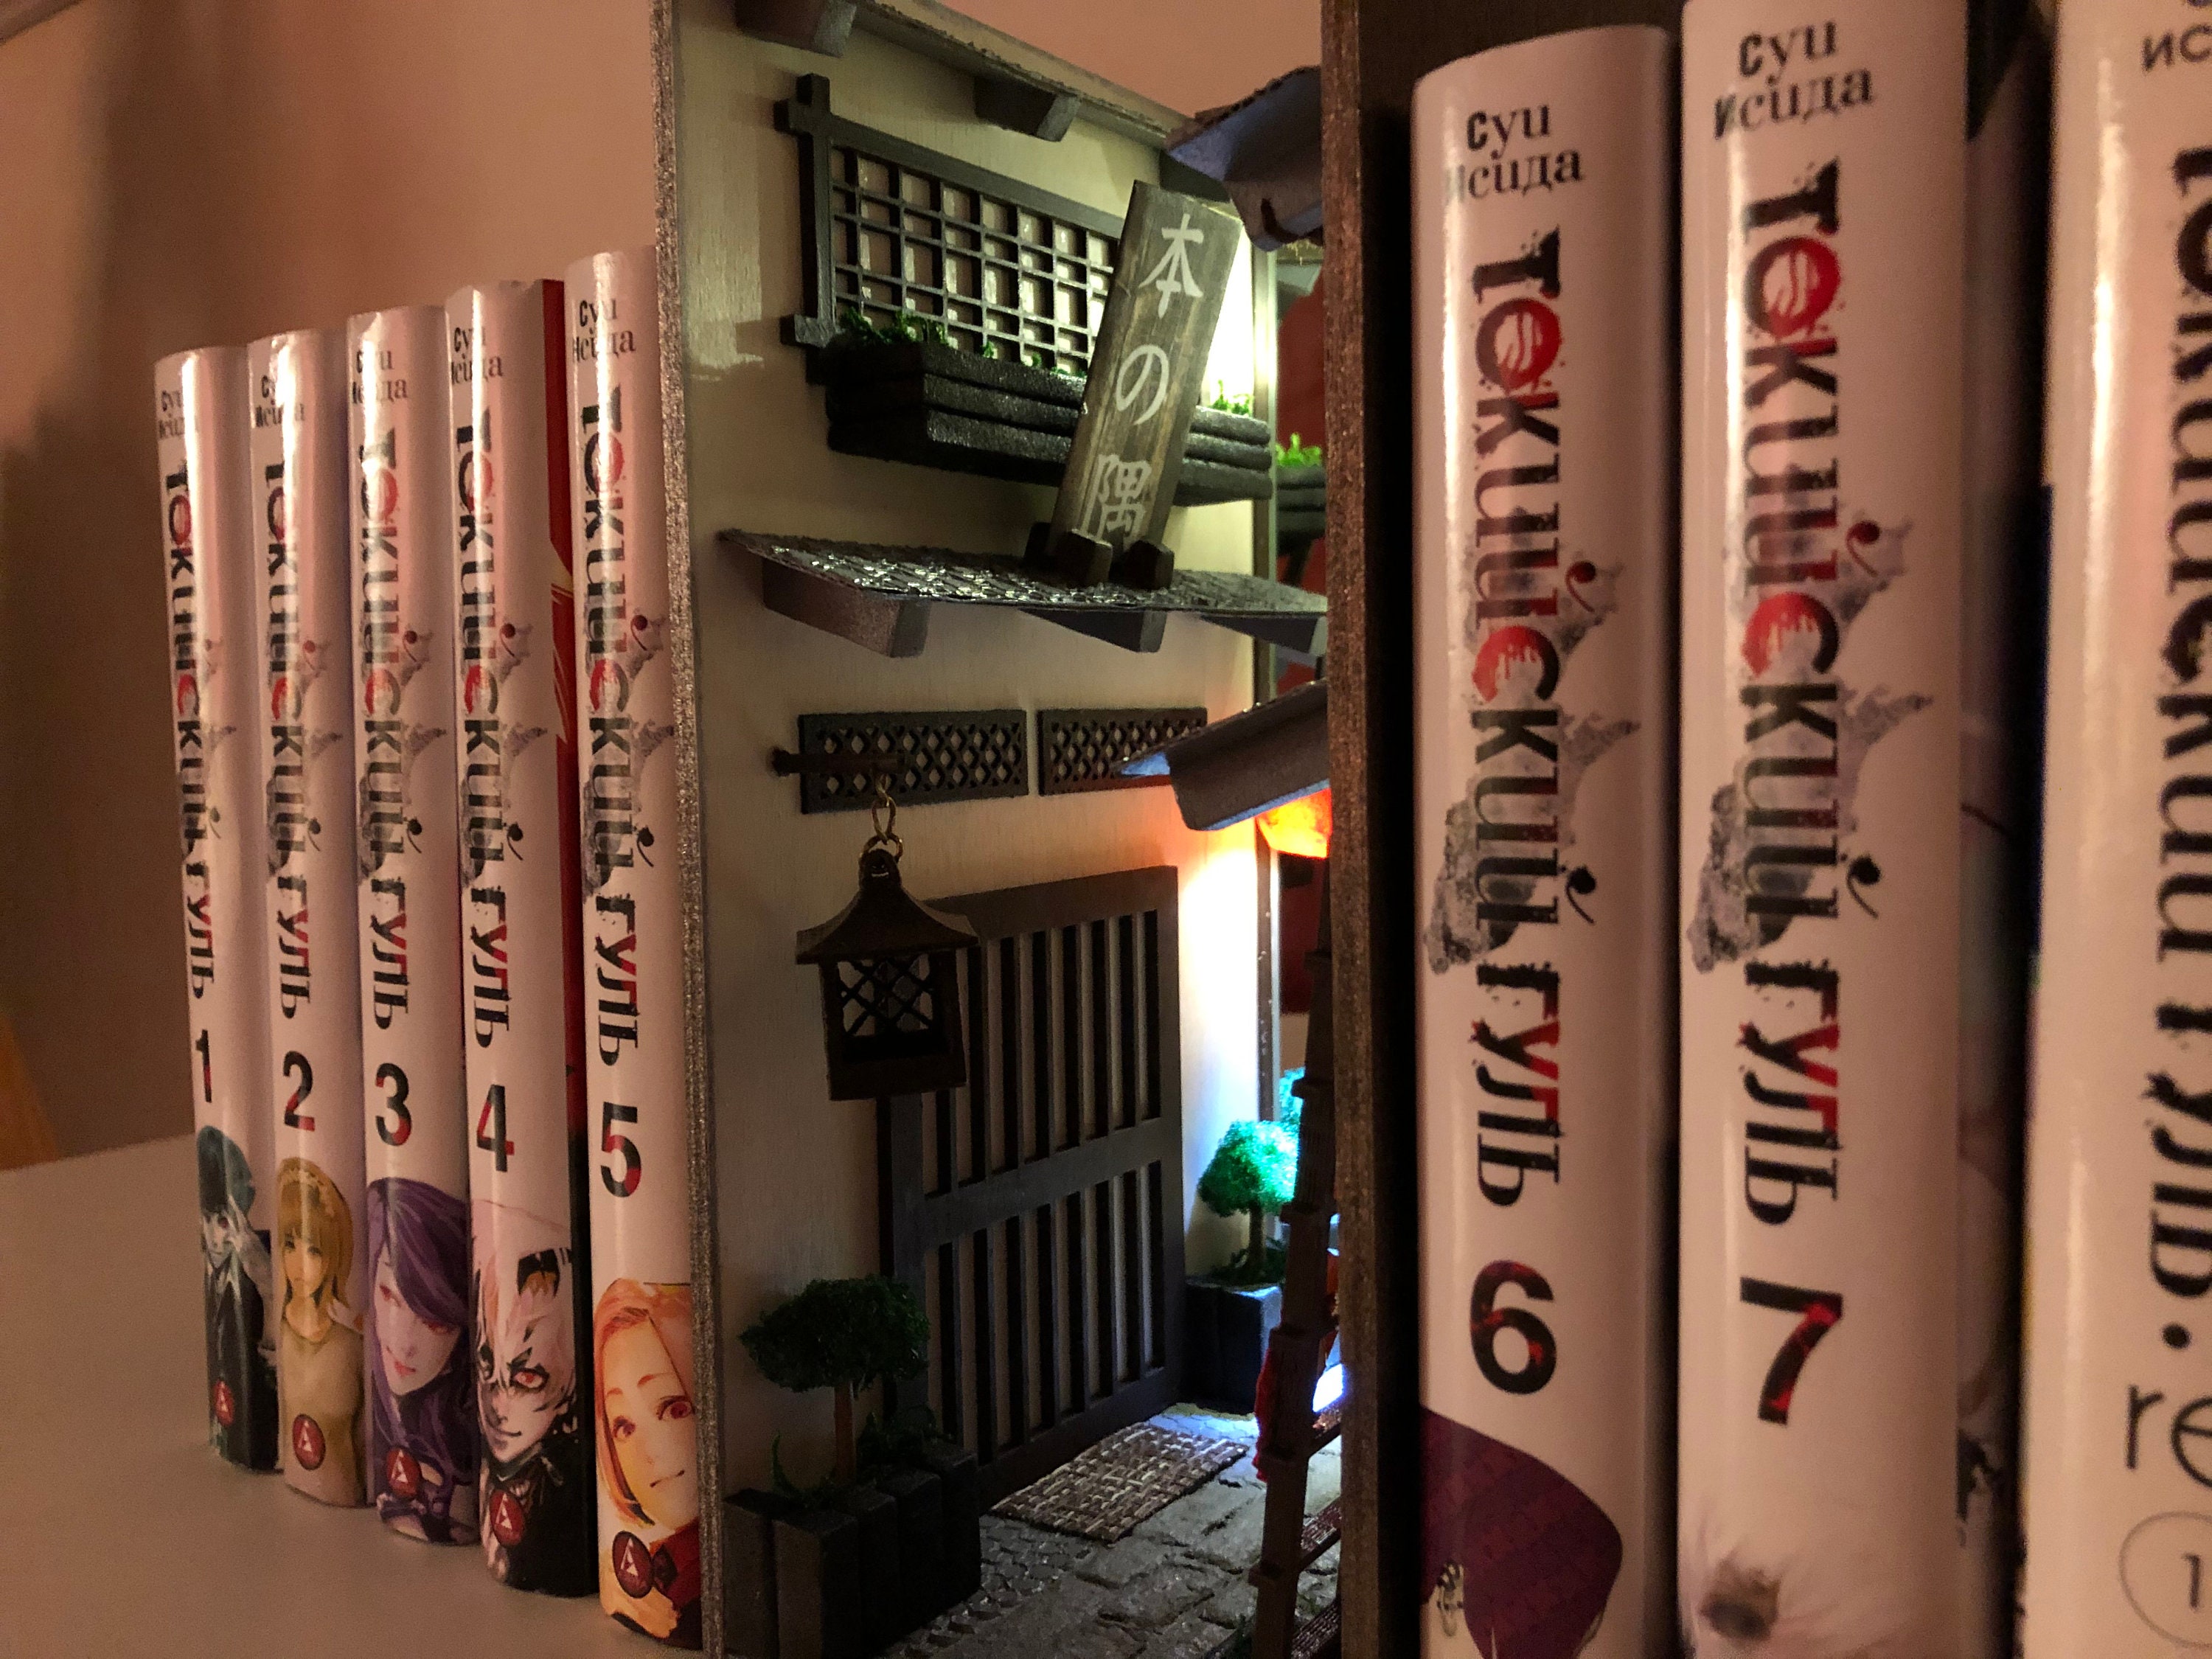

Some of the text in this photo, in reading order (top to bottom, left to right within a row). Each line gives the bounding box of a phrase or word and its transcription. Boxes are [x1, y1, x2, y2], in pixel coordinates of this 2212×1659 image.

[1082, 214, 1204, 551] 本の隅
[195, 1029, 212, 1104] 1
[282, 1051, 316, 1133] 2
[375, 1062, 412, 1147] 3
[476, 1082, 515, 1172] 4
[600, 1102, 642, 1199] 5
[1470, 1260, 1557, 1395] 6
[1739, 1276, 1843, 1425] 7
